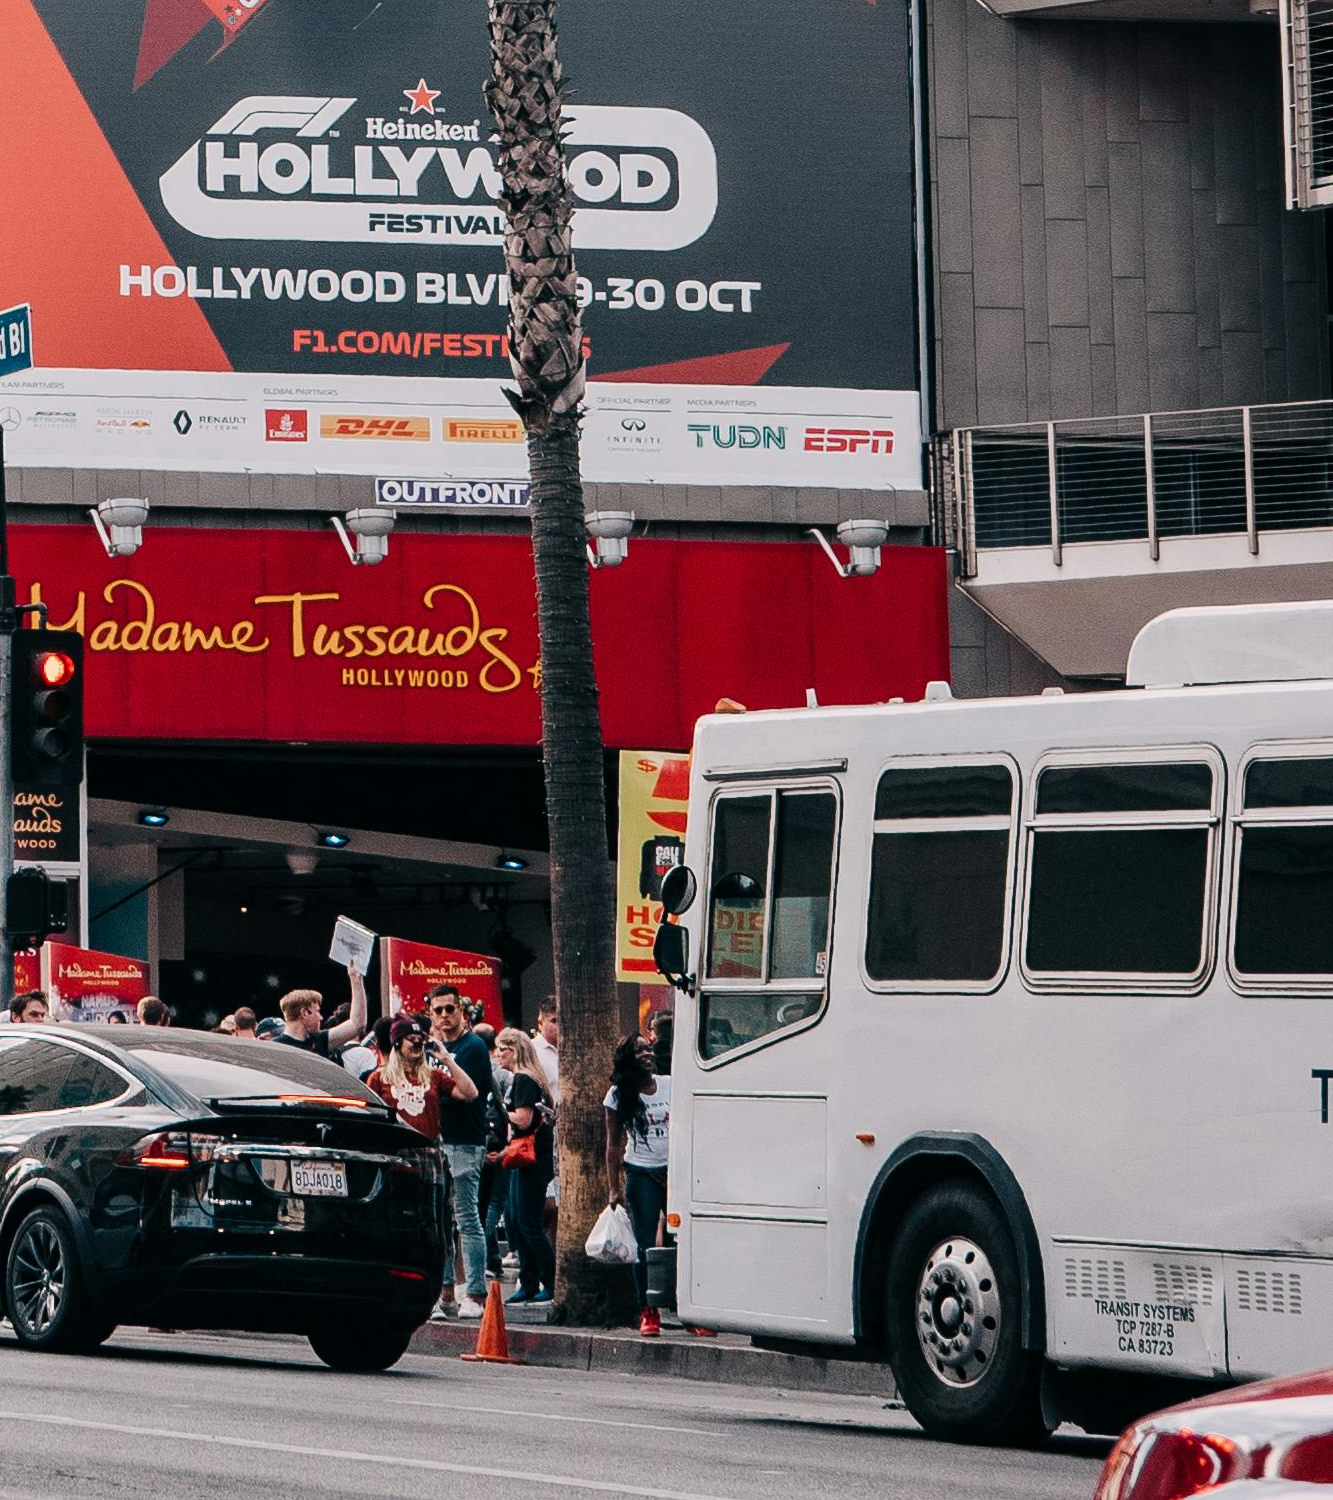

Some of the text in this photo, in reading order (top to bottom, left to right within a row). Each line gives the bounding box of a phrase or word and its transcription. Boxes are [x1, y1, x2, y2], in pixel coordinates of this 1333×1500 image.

[365, 118, 480, 142] Heineken
[205, 141, 671, 204] HOLLYWOD
[369, 213, 505, 235] FESTIVAL
[119, 265, 406, 303] HOLLYWOOD
[676, 279, 761, 312] OCT
[9, 320, 25, 357] Bl
[22, 382, 66, 390] PARTNERS
[295, 388, 338, 397] PARTNERS
[634, 398, 671, 406] PARTNER
[715, 400, 757, 408] PARTNERS
[199, 416, 247, 424] RENAULT
[334, 418, 415, 438] DHL
[448, 421, 519, 440] PIRELLI
[687, 424, 785, 451] TUDN
[804, 428, 894, 454] ESPN
[382, 480, 530, 505] OUTFRONT
[255, 584, 522, 694] Tussauds
[342, 668, 469, 688] HOLLYWOOD
[400, 960, 493, 976] Madame Tussauds
[1095, 1300, 1195, 1322] TRANSIT SYSTEMS
[1116, 1319, 1136, 1335] TCP
[1118, 1337, 1174, 1356] CA 83723
